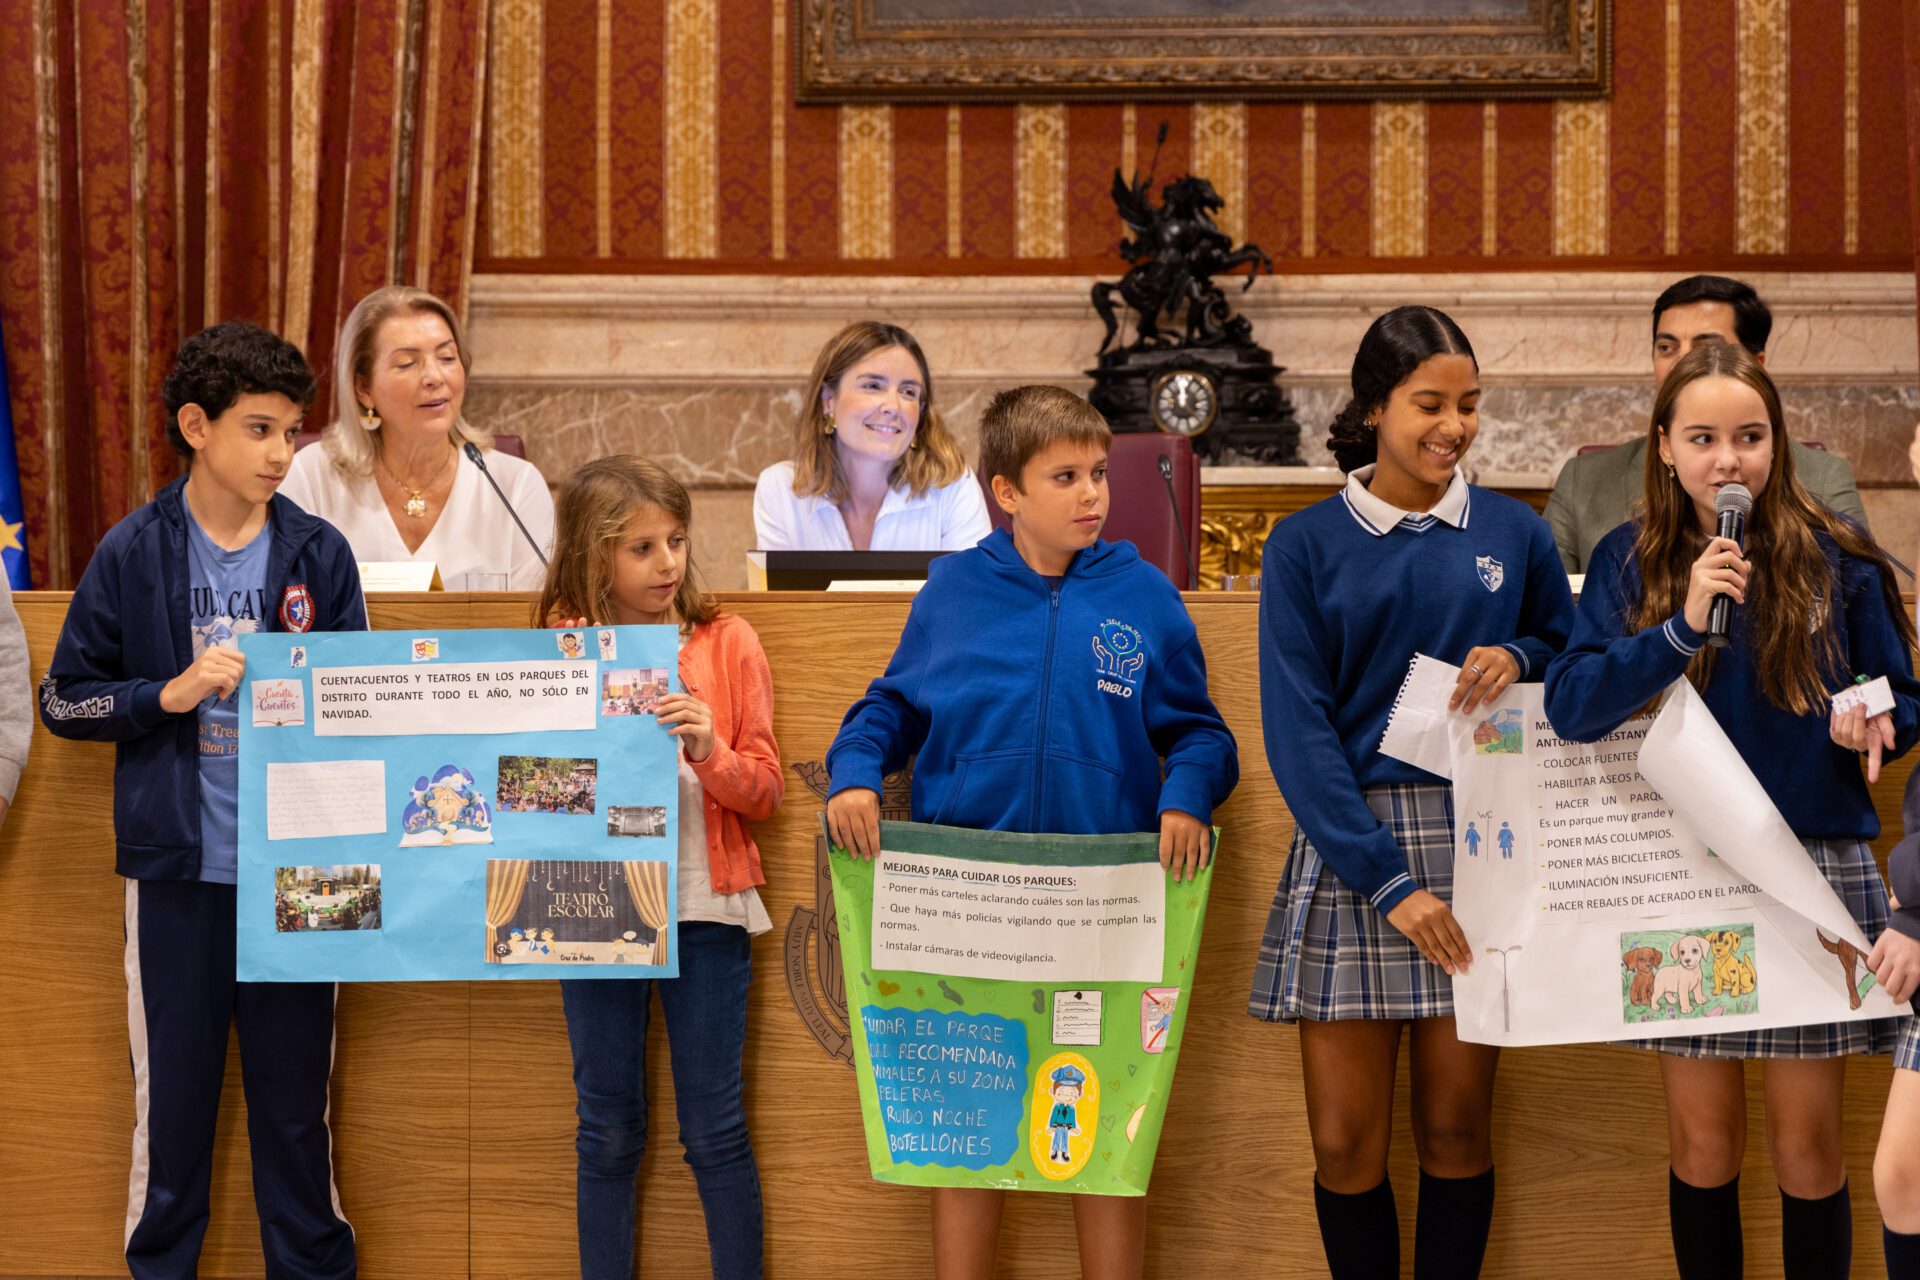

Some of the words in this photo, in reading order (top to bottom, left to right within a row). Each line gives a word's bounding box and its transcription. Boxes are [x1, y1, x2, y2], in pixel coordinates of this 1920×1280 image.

[321, 675, 409, 686] CUENTACUENTOS
[415, 674, 421, 683] Y
[427, 673, 471, 683] TEATROS
[477, 672, 490, 682] EN
[495, 671, 514, 681] LOS
[520, 670, 566, 681] PARQUES
[572, 669, 589, 679] DEL
[321, 693, 367, 702] DISTRITO
[375, 691, 424, 701] DURANTE
[432, 690, 461, 700] TODO
[468, 689, 479, 699] EL
[486, 687, 512, 699] AÑO,
[519, 688, 535, 698] NO
[542, 685, 568, 697] SÓLO
[576, 686, 589, 696] EN
[1097, 679, 1133, 698] PABLO
[260, 697, 296, 712] Cuentos
[322, 709, 373, 719] NAVIDAD.
[1543, 756, 1592, 769] COLOCAR
[1594, 751, 1639, 764] FUENTES
[1544, 776, 1597, 790] HABILITAR
[1599, 772, 1632, 785] ASEOS
[1555, 798, 1589, 810] HACER
[1601, 795, 1617, 806] UN
[1477, 810, 1493, 819] WC
[1539, 819, 1551, 828] Es
[1553, 820, 1566, 828] un
[1569, 816, 1604, 828] parque
[1606, 813, 1629, 823] muy
[1631, 809, 1666, 822] grande
[1667, 809, 1674, 818] y
[1547, 837, 1582, 849] PONER
[1585, 834, 1608, 846] MÁS
[1610, 828, 1675, 843] COLUMPIOS.
[1548, 858, 1583, 870] PONER
[1585, 854, 1609, 867] MÁS
[1611, 849, 1683, 864] BICICLETEROS.
[883, 862, 930, 875] MEJORAS
[932, 867, 959, 879] PARA
[961, 871, 1000, 883] CUIDAR
[1002, 875, 1021, 885] LOS
[1023, 876, 1077, 887] PARQUES:
[1549, 874, 1619, 891] ILUMINACIÓN
[1621, 869, 1693, 885] INSUFICIENTE.
[552, 892, 609, 906] TEATRO
[888, 882, 917, 894] Poner
[920, 887, 939, 897] más
[941, 890, 978, 902] carteles
[980, 893, 1029, 906] aclarando
[1031, 896, 1063, 906] cuáles
[1065, 898, 1084, 906] son
[1086, 897, 1100, 906] las
[1102, 896, 1141, 906] normas.
[1550, 900, 1584, 911] HACER
[1586, 896, 1629, 909] REBAJES
[1631, 895, 1645, 906] DE
[1647, 890, 1696, 904] ACERADO
[1698, 889, 1712, 899] EN
[1715, 887, 1726, 897] EL
[548, 905, 615, 918] ESCOLAR
[889, 903, 911, 914] Que
[914, 905, 938, 918] haya
[942, 909, 961, 920] más
[966, 912, 1003, 924] policías
[1007, 916, 1052, 928] vigilando
[1056, 918, 1076, 928] que
[1097, 915, 1138, 927] cumplan
[1143, 914, 1157, 924] las
[880, 921, 920, 932] normas.
[792, 926, 804, 953] MUY
[885, 941, 922, 952] Instalar
[924, 944, 964, 957] cámaras
[966, 948, 979, 958] de
[981, 950, 1057, 964] videovigilancia.
[792, 955, 804, 989] NOBLE
[799, 992, 815, 1016] MUY
[812, 1017, 831, 1041] LEAL
[915, 1019, 937, 1036] EL
[947, 1020, 1005, 1044] PARQE
[898, 1043, 1017, 1070] RECOMENDADA
[929, 1068, 942, 1085] A
[948, 1070, 967, 1085] SU
[971, 1071, 1016, 1092] ZONA
[879, 1086, 946, 1104] PELERAS
[886, 1105, 924, 1125] RUIDO
[933, 1108, 988, 1127] NOCHE
[890, 1132, 992, 1157] BOTELLONES
